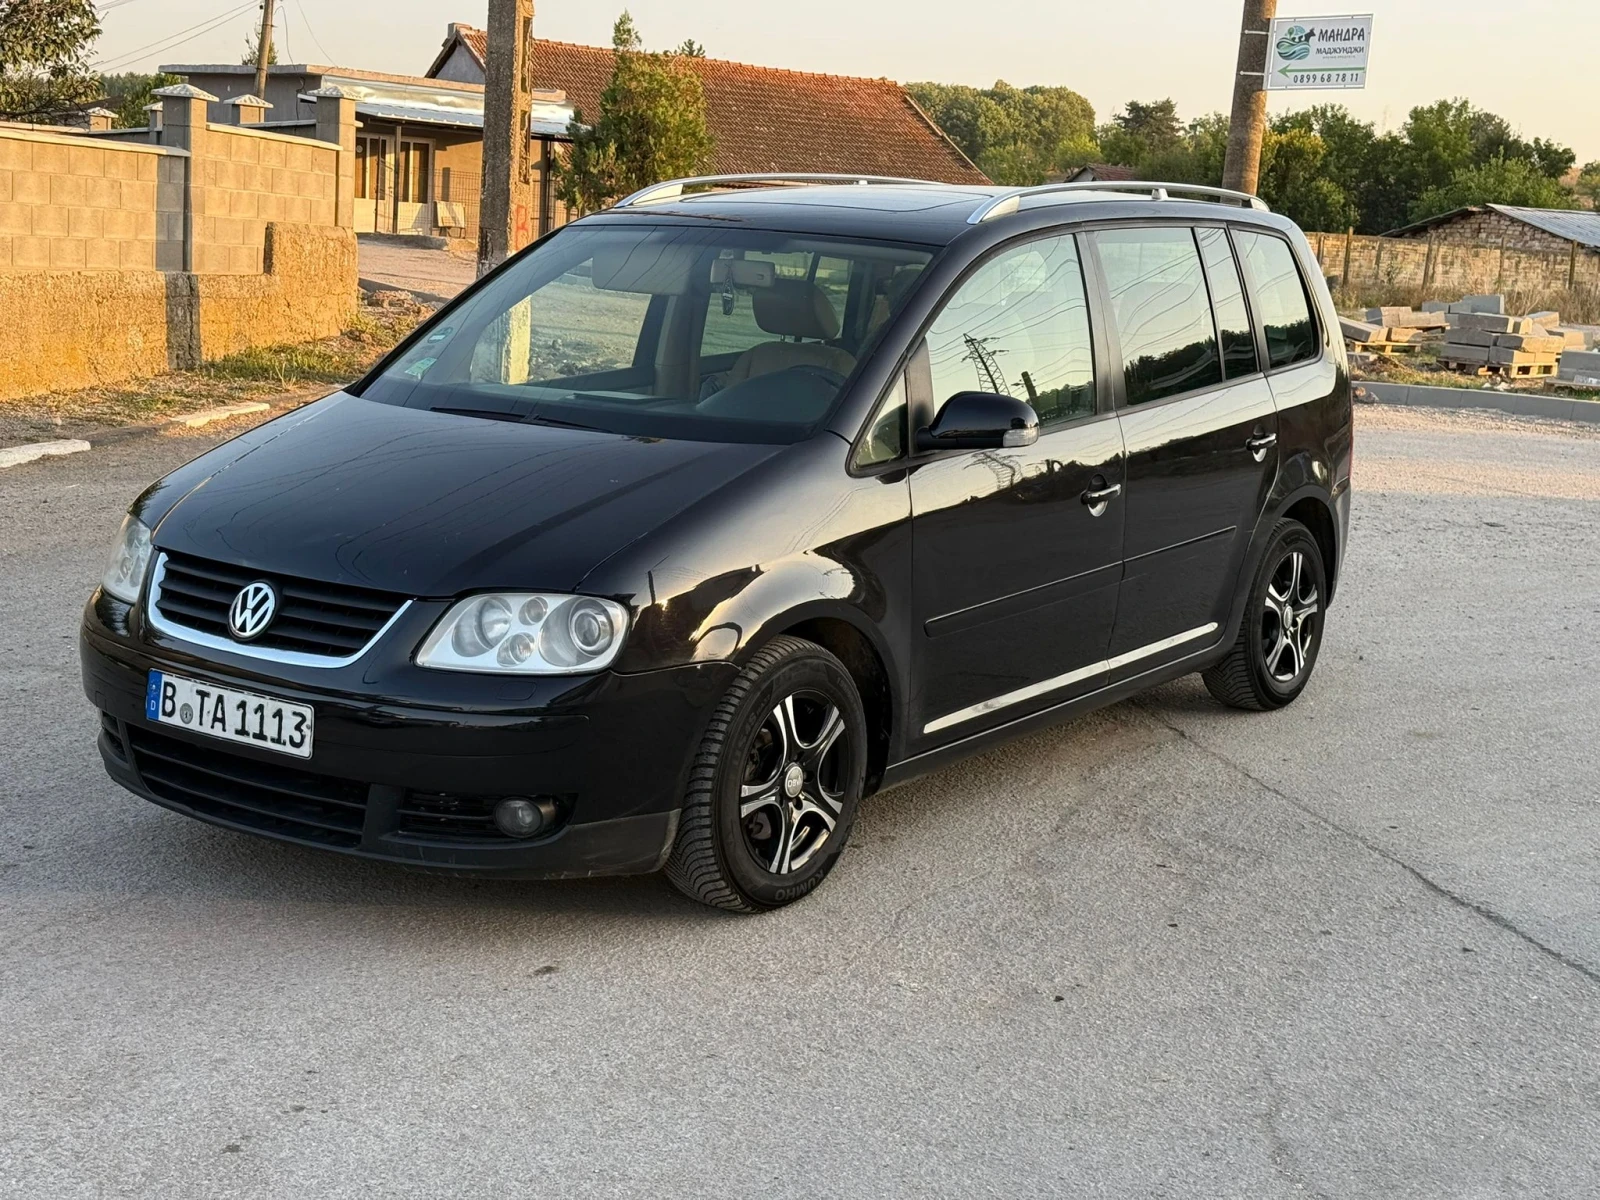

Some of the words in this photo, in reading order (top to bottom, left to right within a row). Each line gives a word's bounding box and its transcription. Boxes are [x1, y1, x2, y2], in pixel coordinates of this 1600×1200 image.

[1318, 27, 1365, 42] МАНДРА
[1316, 46, 1364, 55] МАДЖУНДЖИ
[1293, 74, 1317, 83] 0899
[1320, 73, 1332, 82] 68
[1335, 73, 1347, 82] 78
[1350, 73, 1359, 82] 11
[229, 582, 275, 637] VW
[161, 681, 177, 718] B
[775, 870, 825, 901] KUMHO
